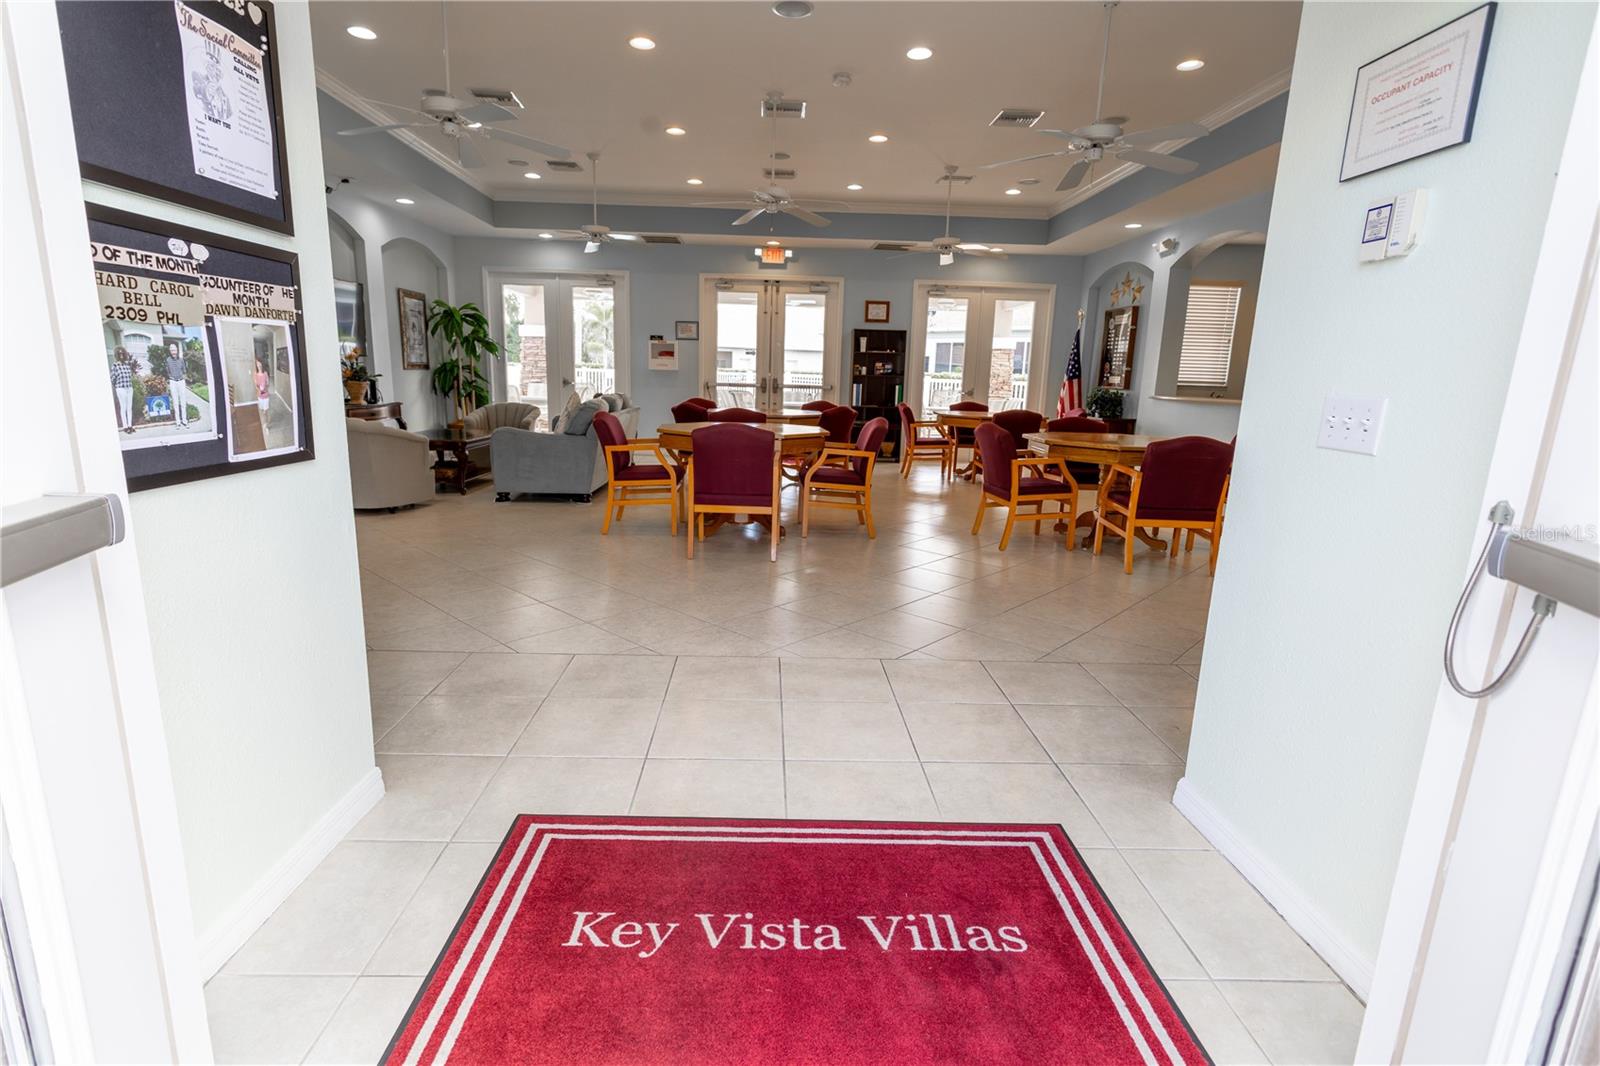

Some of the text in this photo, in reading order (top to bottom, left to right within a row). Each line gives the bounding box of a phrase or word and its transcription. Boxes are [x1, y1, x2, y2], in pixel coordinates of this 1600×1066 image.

[180, 8, 199, 33] The
[200, 18, 228, 49] Social
[233, 65, 245, 76] ALL
[1371, 80, 1412, 105] OCCUPANT
[1413, 63, 1454, 87] CAPACITY
[102, 246, 121, 261] OF
[126, 251, 153, 267] THE
[156, 256, 200, 274] MONTH
[95, 271, 195, 298] HARD CAROL
[200, 275, 294, 299] VOLUNTEER OF HE
[122, 291, 162, 307] BELL
[232, 293, 269, 308] MONTH
[104, 305, 183, 326] 2309 PHL
[206, 303, 294, 321] DAWN DANFORTH
[561, 911, 1028, 958] Key Vista Villas
